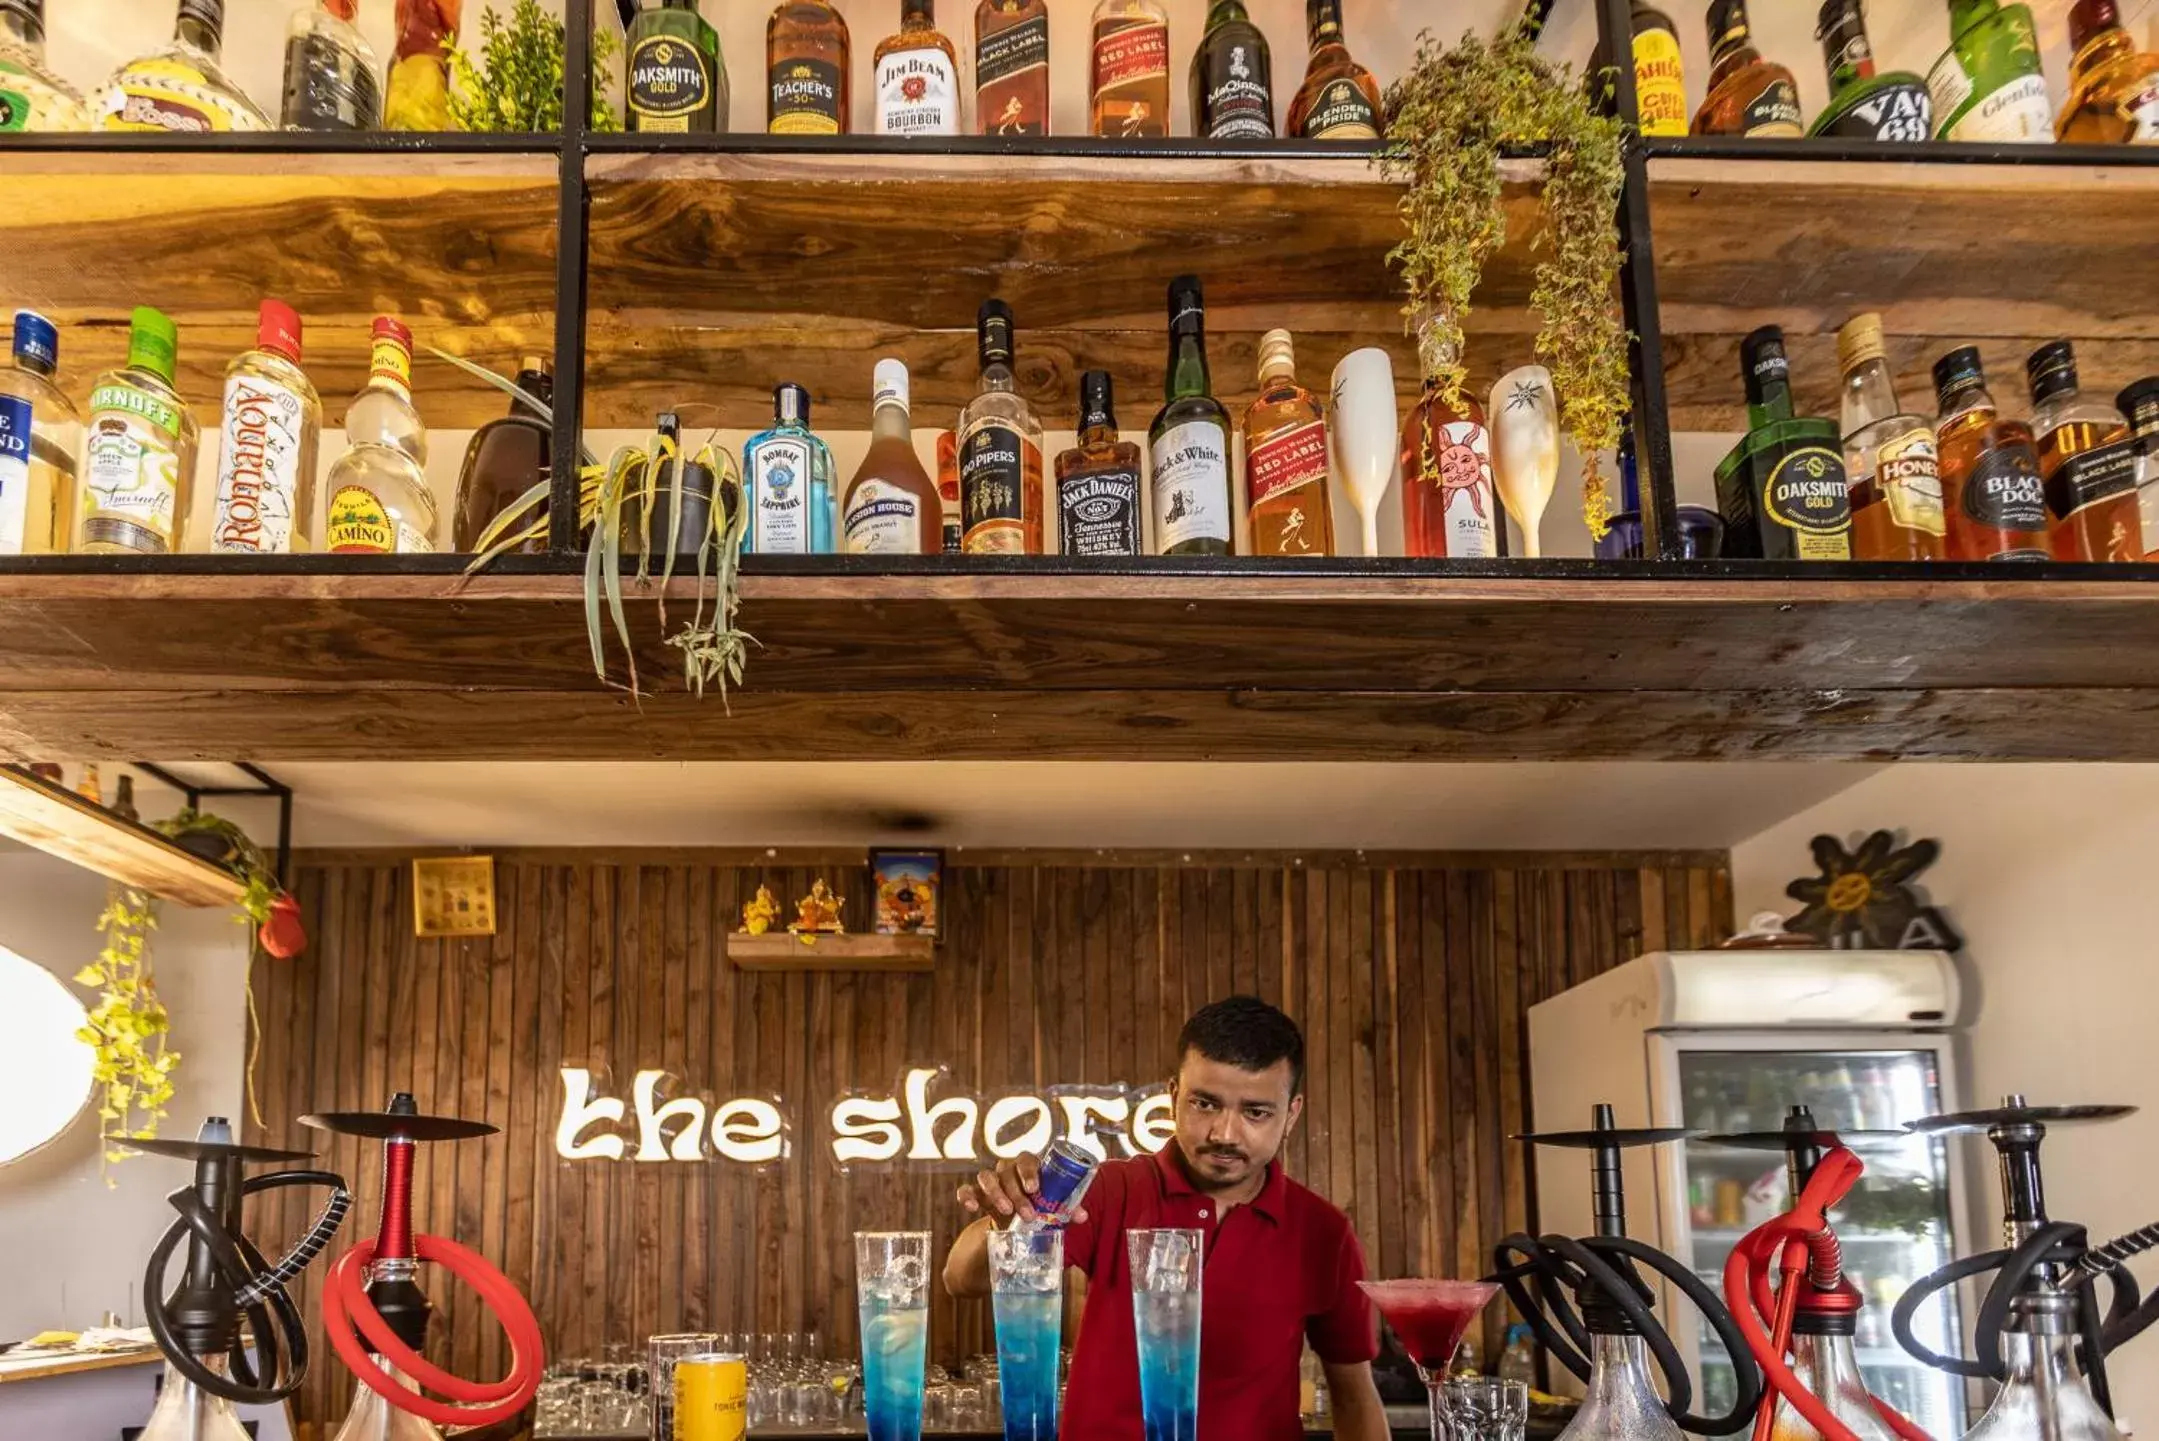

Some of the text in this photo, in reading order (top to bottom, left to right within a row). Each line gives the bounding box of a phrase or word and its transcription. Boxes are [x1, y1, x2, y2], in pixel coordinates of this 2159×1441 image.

[977, 47, 1010, 67] BLACK
[1012, 34, 1046, 52] LABEL
[1100, 50, 1124, 66] RED
[1127, 40, 1165, 56] LABEL
[631, 67, 700, 89] OAKSMITH
[881, 58, 945, 89] JIM BEAM
[650, 81, 677, 94] GOLD
[772, 81, 833, 103] TEACHER'S
[1309, 104, 1371, 129] BLENDERS
[1850, 90, 1933, 127] VAT
[887, 113, 942, 131] BOURBON
[1322, 112, 1360, 128] PRIDE
[1876, 117, 1927, 142] 69
[763, 448, 800, 465] BOMBAY
[976, 450, 1016, 468] PIPERS
[1255, 441, 1325, 476] RED LABEL
[1062, 480, 1135, 509] JACK DANIEL'S
[1805, 497, 1833, 509] GOLD
[877, 502, 914, 514] HOUSE
[1074, 521, 1122, 533] Tennessee
[1076, 532, 1122, 545] WHISKEY
[556, 1067, 1176, 1163] the shore
